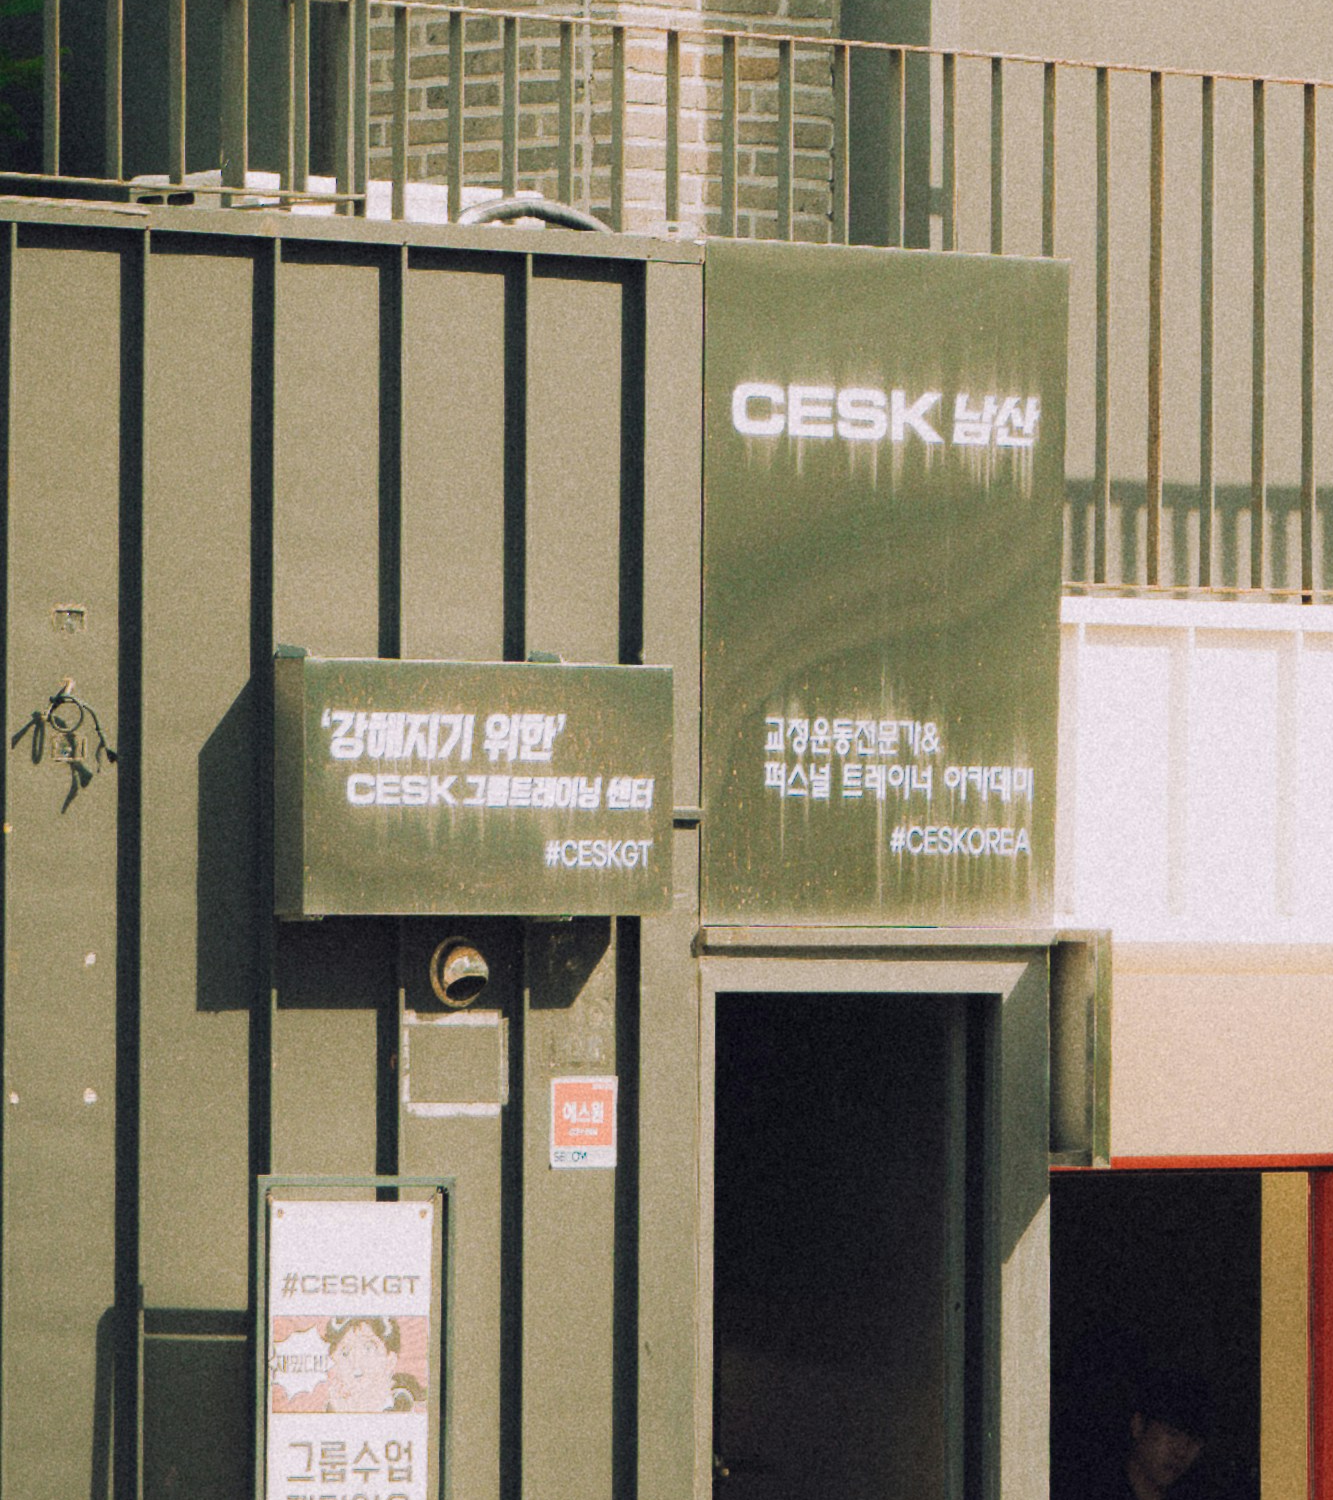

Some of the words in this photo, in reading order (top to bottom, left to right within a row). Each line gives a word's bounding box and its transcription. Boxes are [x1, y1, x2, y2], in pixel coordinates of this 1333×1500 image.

[732, 381, 946, 444] CESK
[952, 392, 1041, 448] 남산
[346, 772, 459, 808] CESK
[461, 774, 602, 811] 그룹트레이닝
[605, 777, 656, 812] 센터
[764, 761, 832, 799] 퍼스널
[841, 763, 934, 802] 트레이너
[943, 765, 1035, 805] 아카데미
[544, 838, 653, 870] #CESKGT
[889, 825, 1032, 857] #CESKOREA
[281, 1272, 421, 1298] #CESKGT
[286, 1440, 412, 1484] 그룹수업
